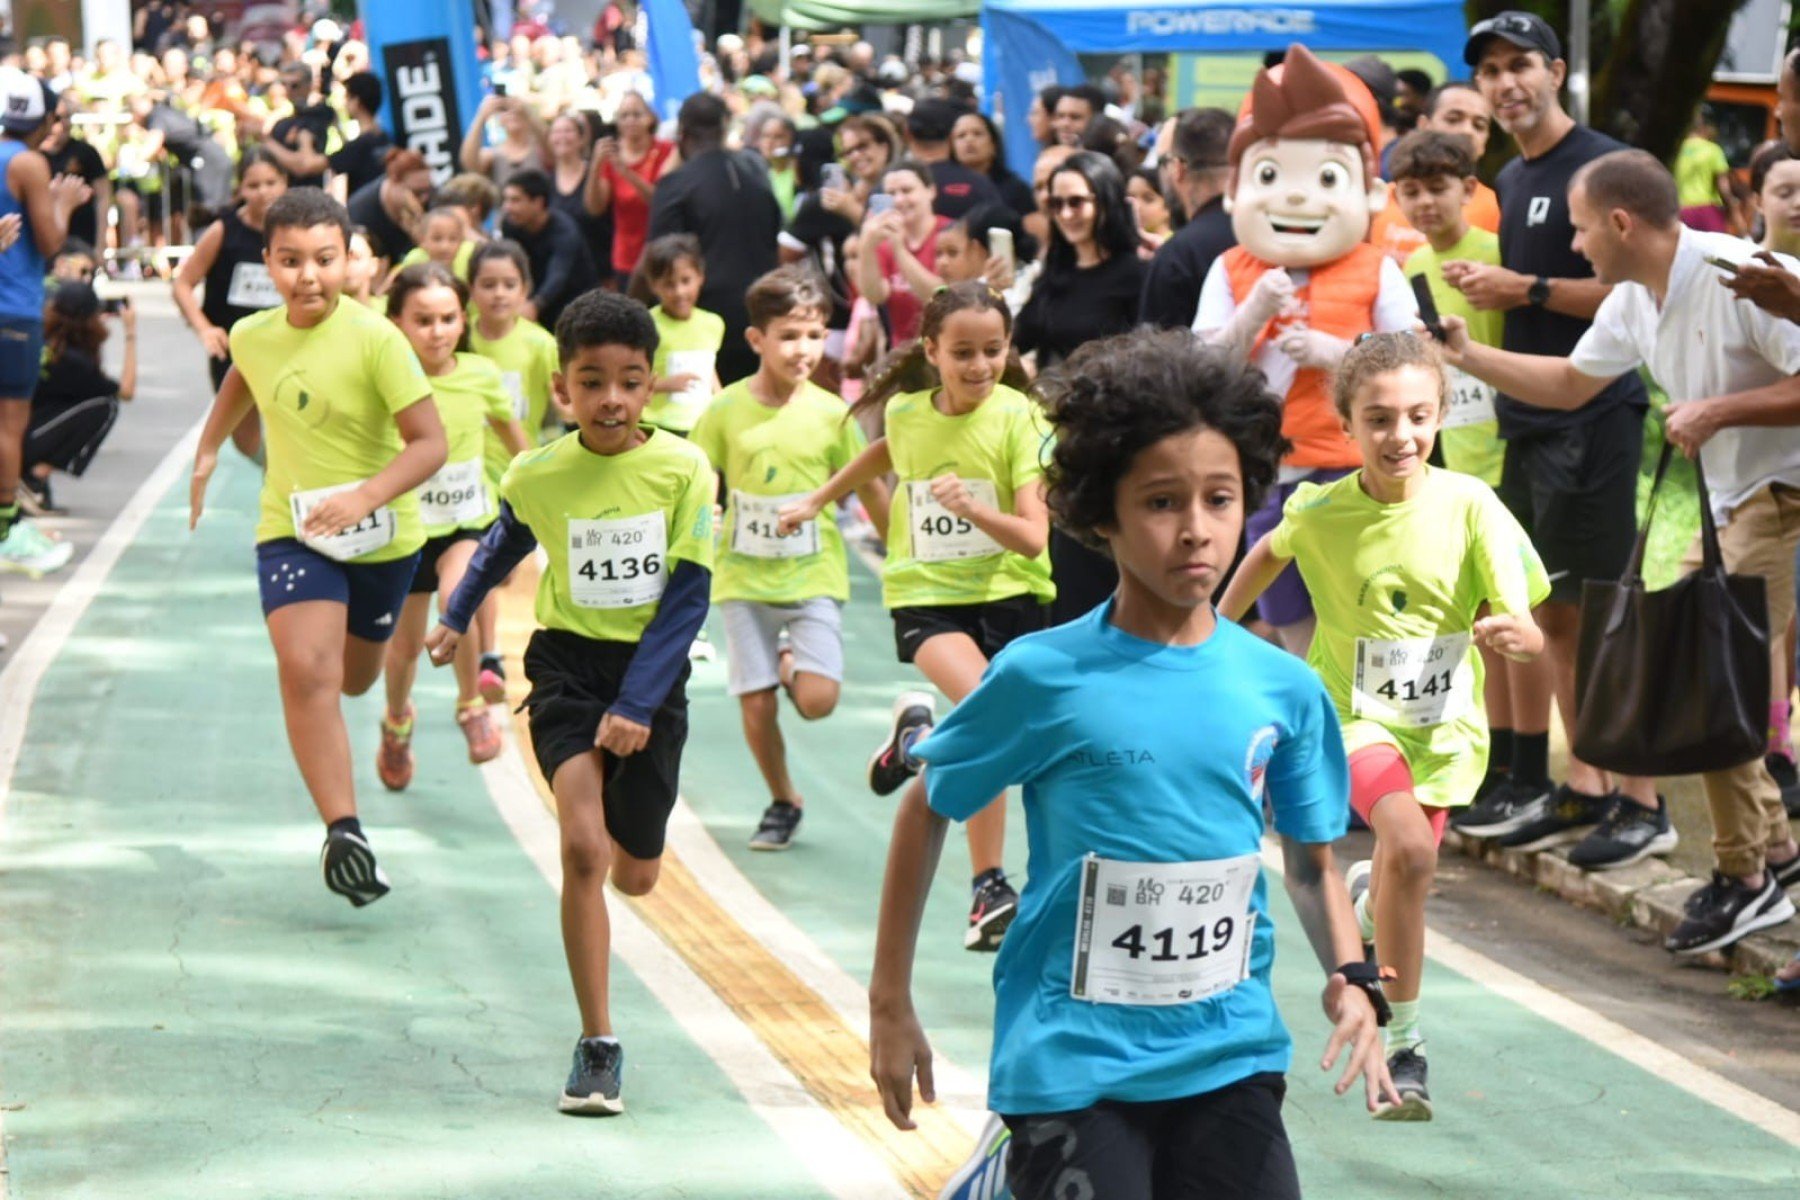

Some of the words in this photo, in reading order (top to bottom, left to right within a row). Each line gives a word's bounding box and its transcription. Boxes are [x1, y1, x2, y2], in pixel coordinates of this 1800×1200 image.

[420, 485, 476, 505] 4096
[611, 530, 643, 546] 420
[577, 552, 661, 581] 4136
[1376, 669, 1453, 701] 4141
[1178, 882, 1225, 906] 420
[1111, 916, 1235, 962] 4119
